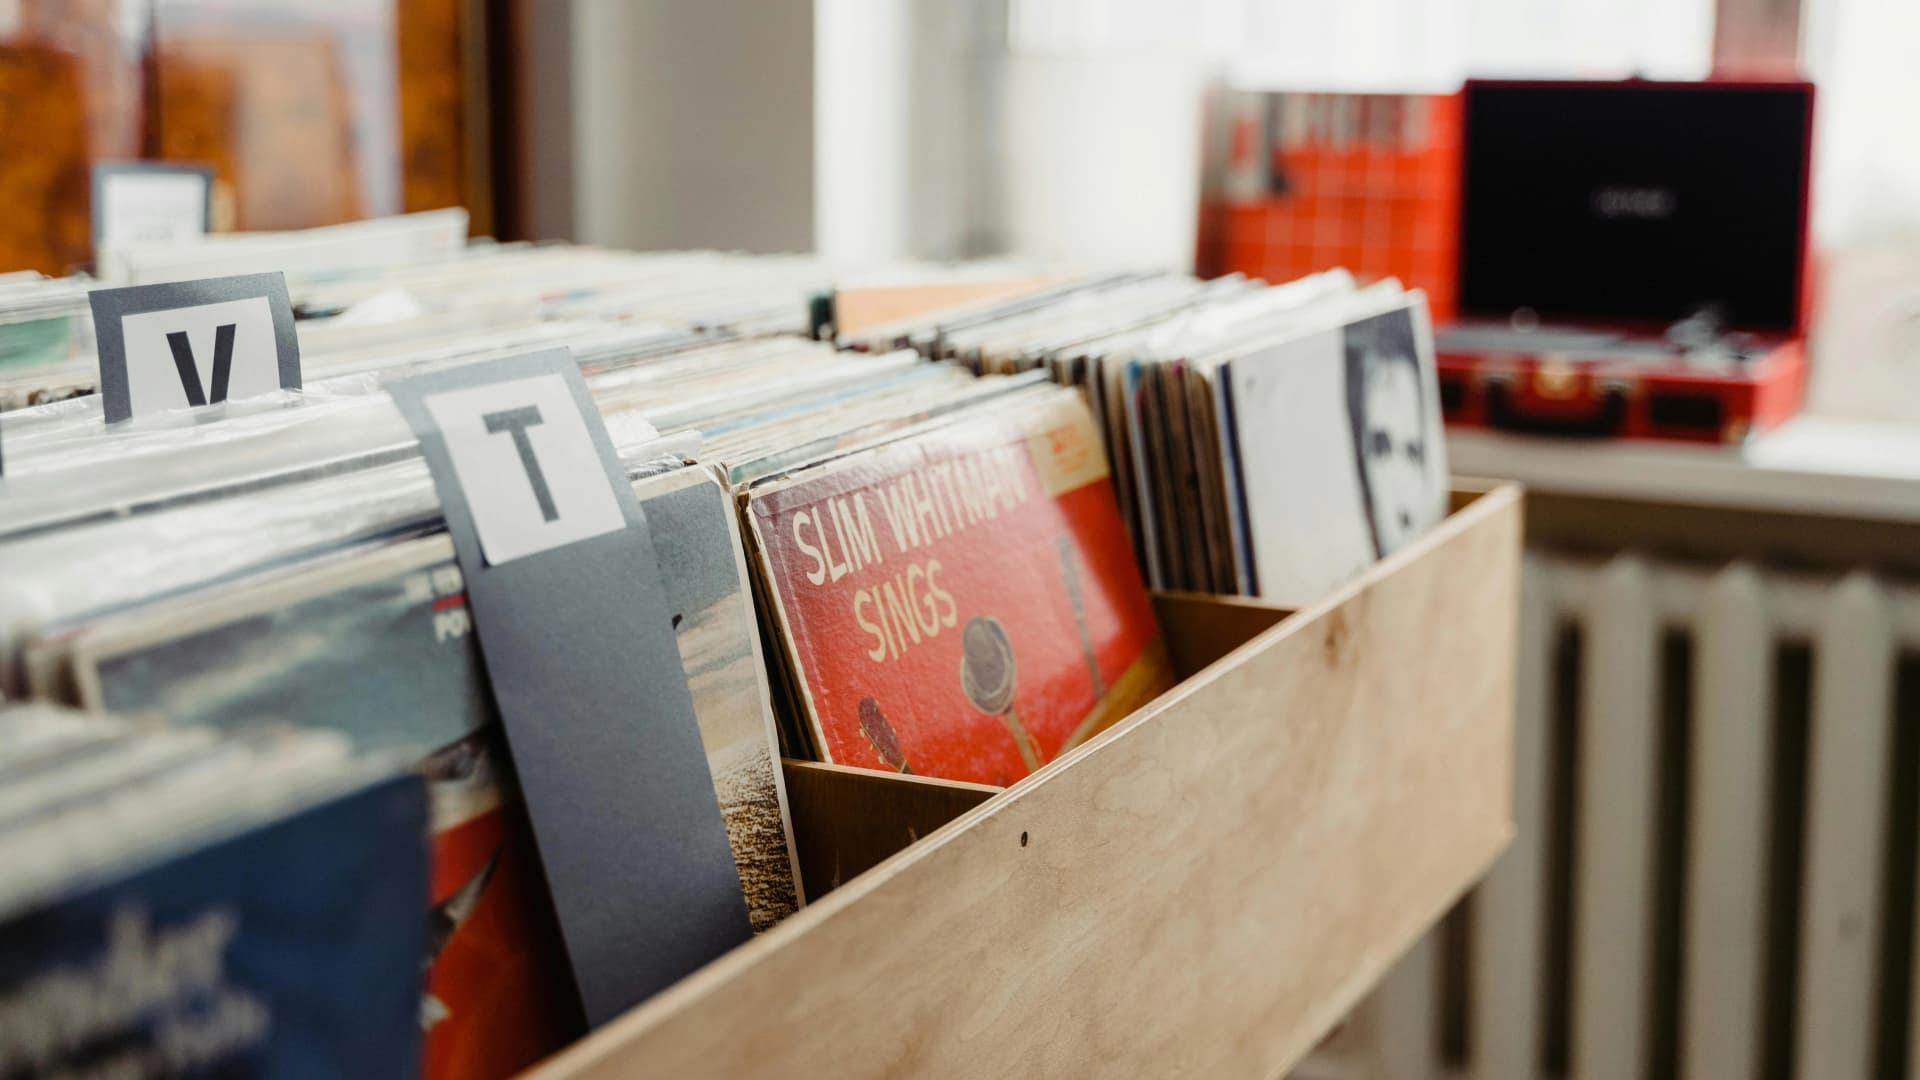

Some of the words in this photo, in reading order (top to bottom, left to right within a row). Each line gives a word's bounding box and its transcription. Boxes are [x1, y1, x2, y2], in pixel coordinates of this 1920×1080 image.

[165, 323, 237, 408] V
[482, 404, 560, 523] T
[792, 492, 883, 586] SLIM
[875, 444, 1026, 553] WHITMAN
[853, 559, 957, 662] SINGS
